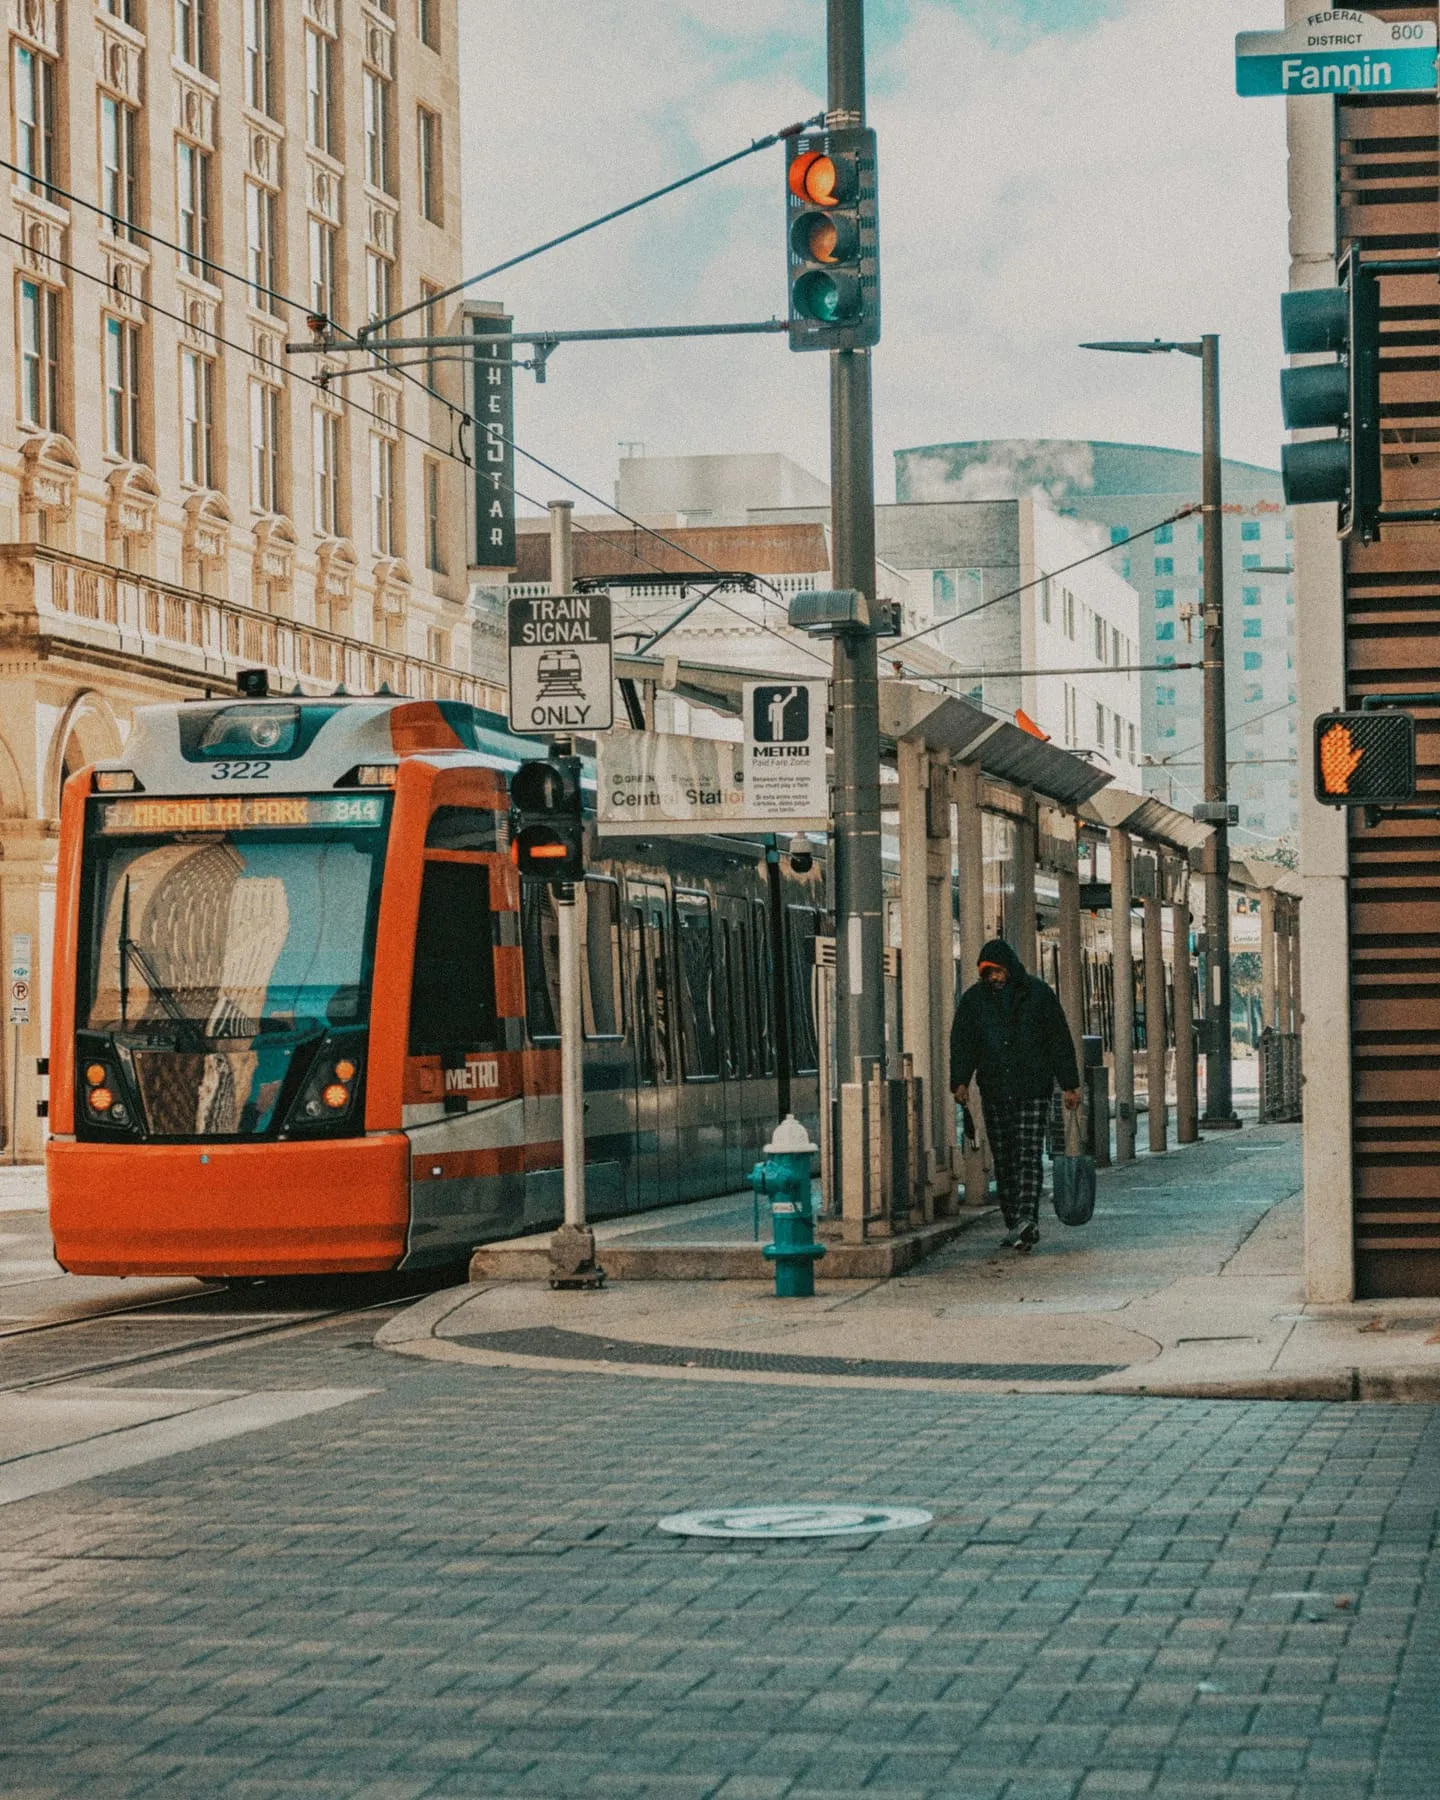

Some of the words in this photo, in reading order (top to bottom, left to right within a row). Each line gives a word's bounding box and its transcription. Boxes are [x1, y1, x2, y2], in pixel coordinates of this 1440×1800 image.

[1307, 10, 1364, 26] FEDERAL
[1307, 34, 1363, 46] DISTRICT
[1391, 24, 1424, 40] 800
[1281, 56, 1392, 90] Fannin
[486, 422, 504, 547] STAR
[529, 599, 591, 620] TRAIN
[522, 621, 598, 643] SIGNAL
[531, 705, 591, 725] ONLY
[753, 746, 810, 757] METRO
[211, 762, 271, 780] 322
[752, 759, 769, 767] Paid
[790, 759, 811, 767] Zone
[134, 802, 243, 827] MAGNOLIA
[254, 800, 310, 824] PARK
[445, 1061, 499, 1090] METRO
